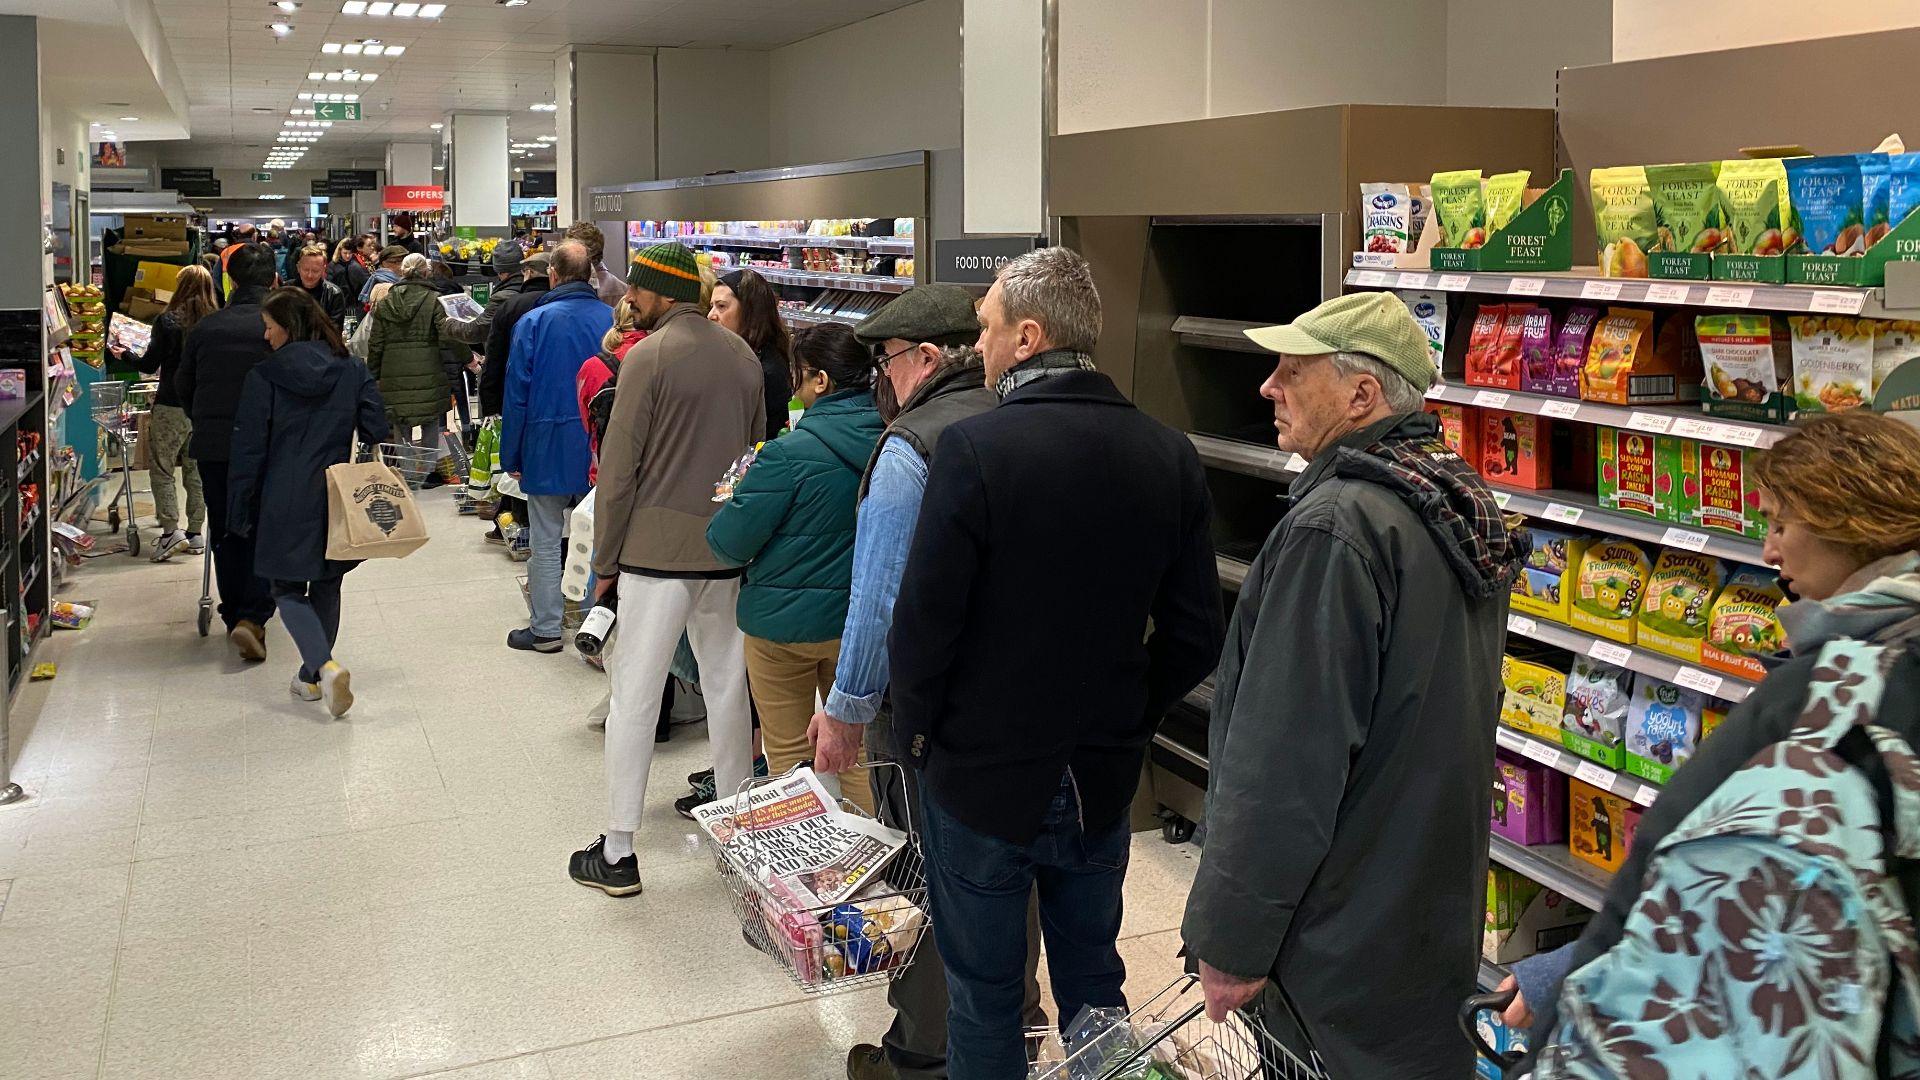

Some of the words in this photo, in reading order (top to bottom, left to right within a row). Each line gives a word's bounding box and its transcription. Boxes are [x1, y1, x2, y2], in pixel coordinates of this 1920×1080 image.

[1662, 180, 1704, 191] FOREST
[1726, 179, 1765, 189] FOREST
[1799, 174, 1846, 187] FOREST
[406, 190, 444, 200] OFFERS
[1440, 187, 1471, 196] FOREST
[1602, 186, 1645, 196] FOREST
[1667, 190, 1702, 200] FEAST
[1729, 190, 1760, 199] FEAST
[1802, 186, 1842, 198] FEAST
[1442, 196, 1468, 204] FEAST
[1606, 196, 1640, 206] FEAST
[1606, 221, 1634, 231] PEAR
[1507, 235, 1546, 246] FOREST
[1511, 246, 1543, 257] FEAST
[1896, 240, 1920, 253] FOR
[1441, 252, 1466, 261] FOREST
[1661, 257, 1692, 266] FOREST
[955, 256, 979, 269] FOOD
[981, 256, 993, 269] TO
[1443, 260, 1465, 268] FEAST
[1726, 260, 1760, 270] FOREST
[1802, 262, 1840, 272] FOREST
[1664, 266, 1690, 275] FEAST
[1730, 269, 1758, 279] FEAST
[1806, 272, 1837, 281] FEAST
[1524, 314, 1548, 327] URBAN
[1567, 312, 1593, 325] URBAN
[1607, 317, 1637, 328] URBAN
[1474, 323, 1496, 335] FRUIT
[1523, 327, 1546, 339] FRUIT
[1562, 323, 1587, 335] FRUIT
[1603, 326, 1634, 342] FRUIT
[1800, 359, 1861, 372] GOLDENBERRY
[1503, 432, 1516, 440] BEAR
[1626, 463, 1644, 473] SOUR
[1621, 469, 1650, 483] RAISIN
[1626, 481, 1646, 492] SNACKS
[1711, 478, 1731, 488] SOUR
[1705, 484, 1739, 500] RAISIN
[1710, 498, 1733, 509] SNACKS
[1600, 546, 1639, 566] Sunny
[1662, 555, 1710, 576] Sunny
[1731, 587, 1777, 609] Sunn
[1703, 649, 1720, 661] REAL
[1720, 653, 1742, 666] FRUIT
[1648, 711, 1684, 735] yogurt
[699, 803, 738, 819] Daily
[749, 789, 781, 805] Mail
[789, 793, 814, 806] mums
[771, 811, 787, 820] this
[788, 799, 817, 812] Sunday
[726, 824, 800, 855] SCHOOL'S
[799, 814, 834, 832] OUT,
[737, 837, 795, 866] EXAMS
[796, 825, 842, 846] AXED,
[744, 846, 809, 877] DEATHS
[808, 829, 851, 854] SOAR
[768, 858, 801, 877] AND
[802, 845, 843, 868] ARMY
[842, 831, 862, 846] IN
